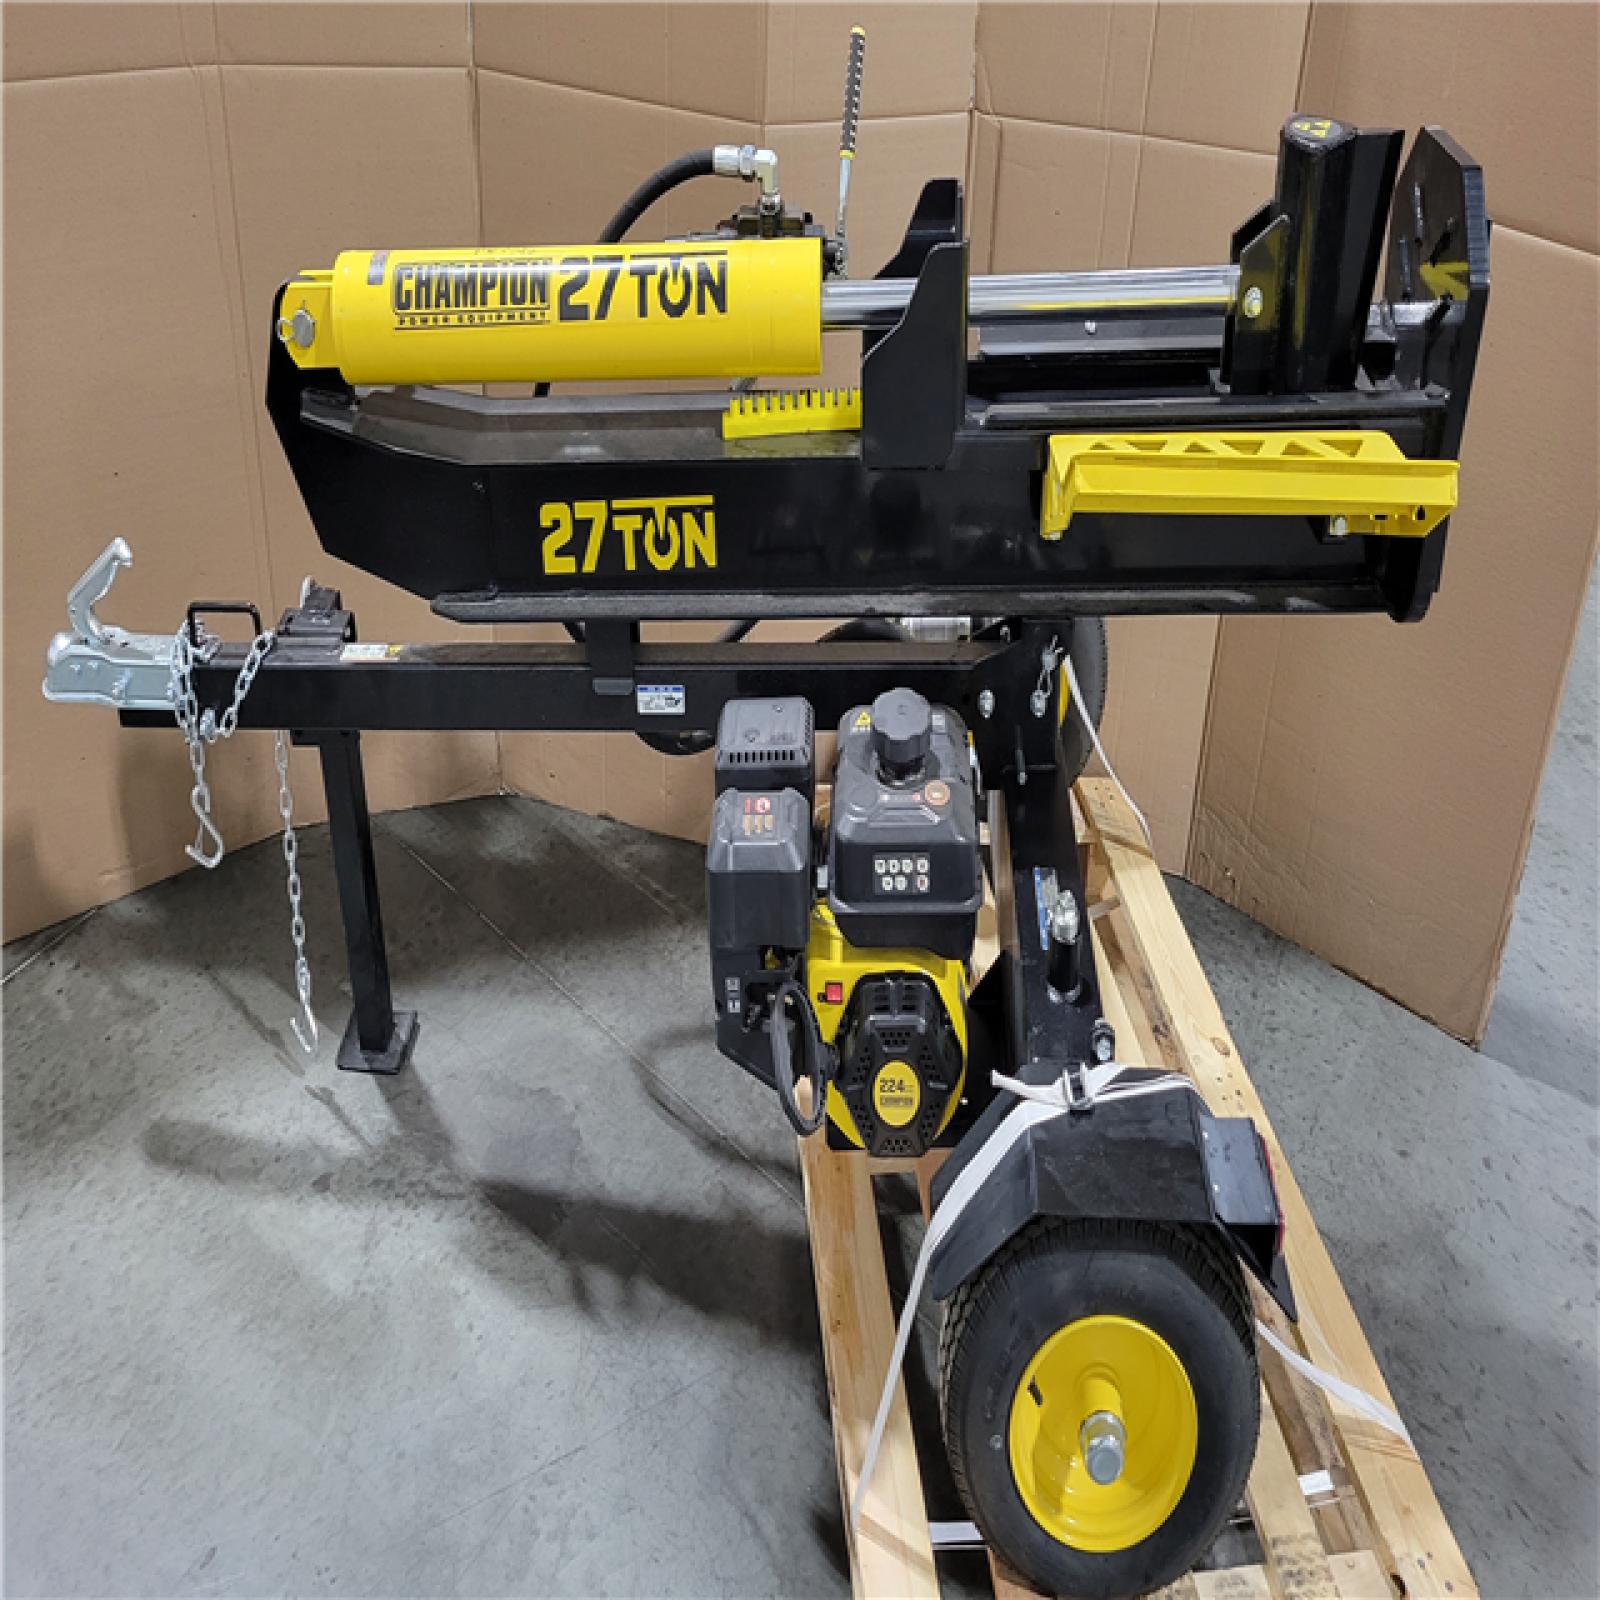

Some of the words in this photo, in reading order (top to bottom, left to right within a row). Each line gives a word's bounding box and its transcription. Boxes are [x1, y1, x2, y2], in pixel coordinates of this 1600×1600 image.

[395, 261, 549, 310] CHAMPION
[559, 255, 624, 320] 27
[630, 251, 728, 318] TON
[540, 500, 607, 575] 27
[611, 496, 717, 571] TON
[879, 1077, 905, 1093] 224
